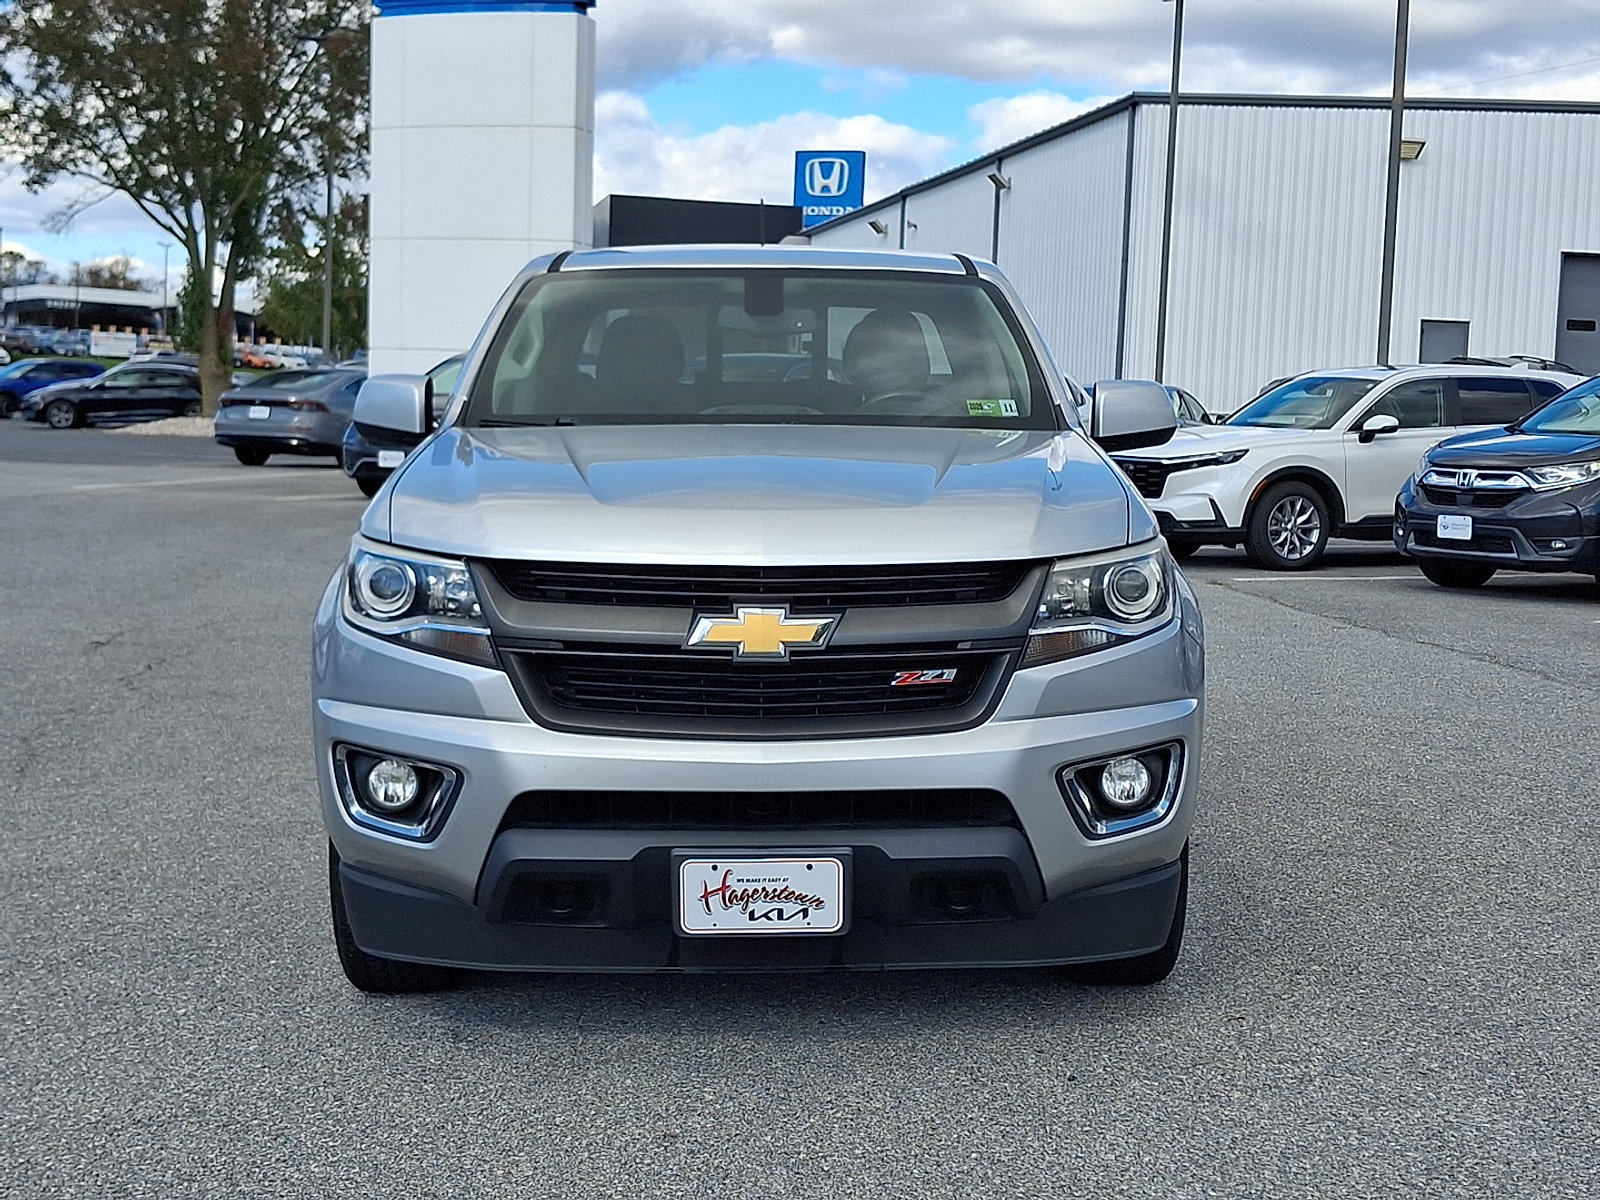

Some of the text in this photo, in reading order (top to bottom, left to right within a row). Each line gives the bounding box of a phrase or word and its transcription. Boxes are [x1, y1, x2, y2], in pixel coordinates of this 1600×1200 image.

[1003, 403, 1014, 413] 11
[891, 668, 957, 686] Z71
[699, 869, 825, 914] Hagerstown
[748, 907, 809, 922] KIA
